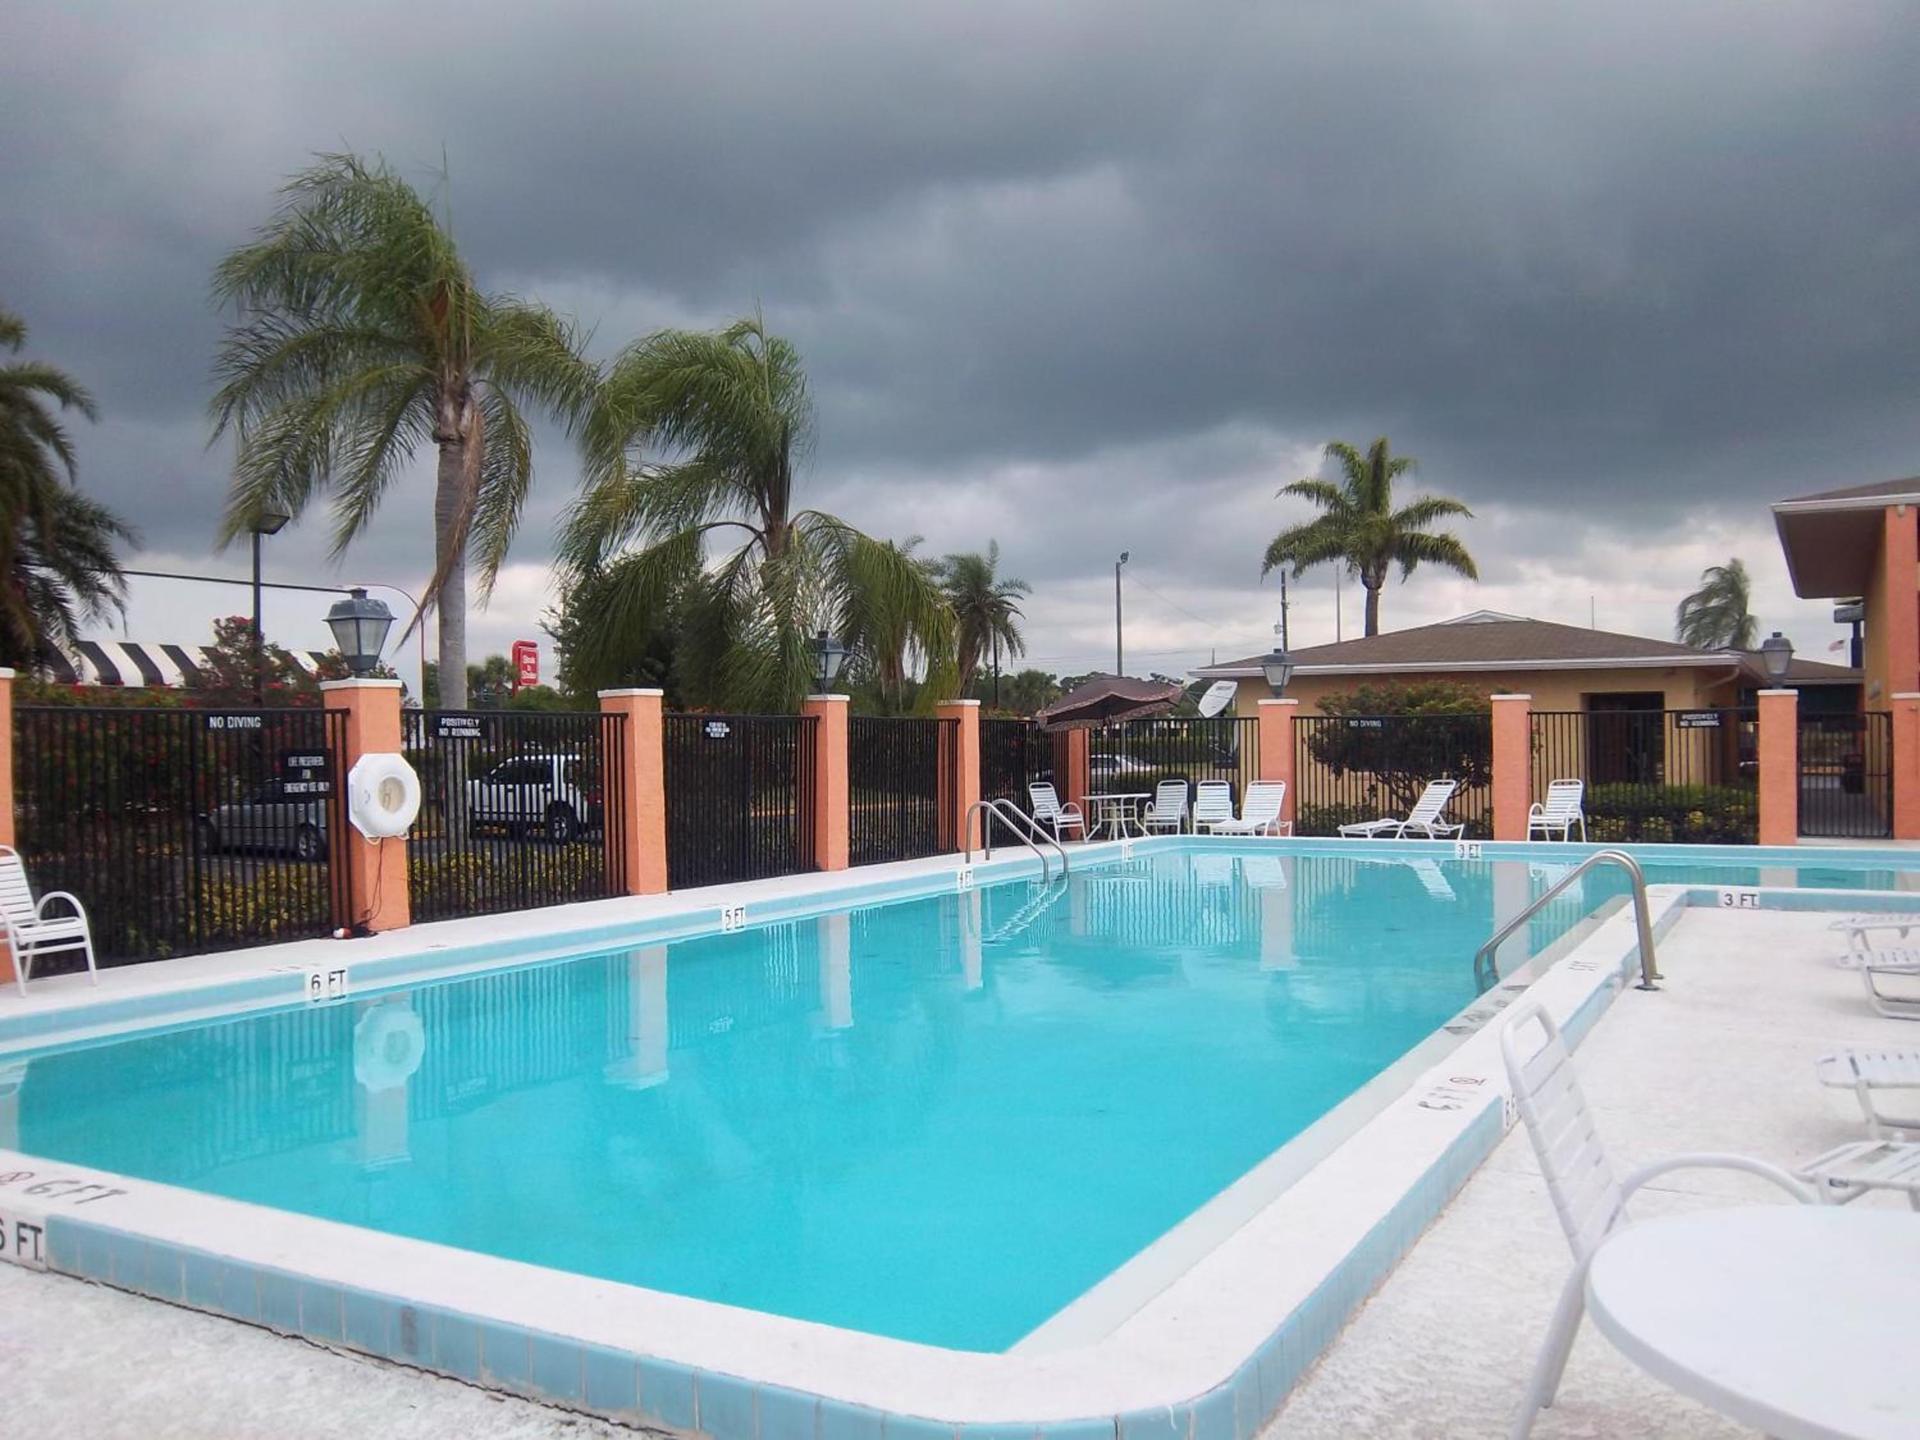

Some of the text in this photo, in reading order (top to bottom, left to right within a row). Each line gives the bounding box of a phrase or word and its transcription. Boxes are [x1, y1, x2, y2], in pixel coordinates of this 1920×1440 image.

[209, 715, 262, 728] NO DIVING
[439, 727, 449, 737] NO
[1724, 892, 1734, 906] 3
[311, 969, 346, 993] 6 FT
[23, 1179, 129, 1205] 6 FT
